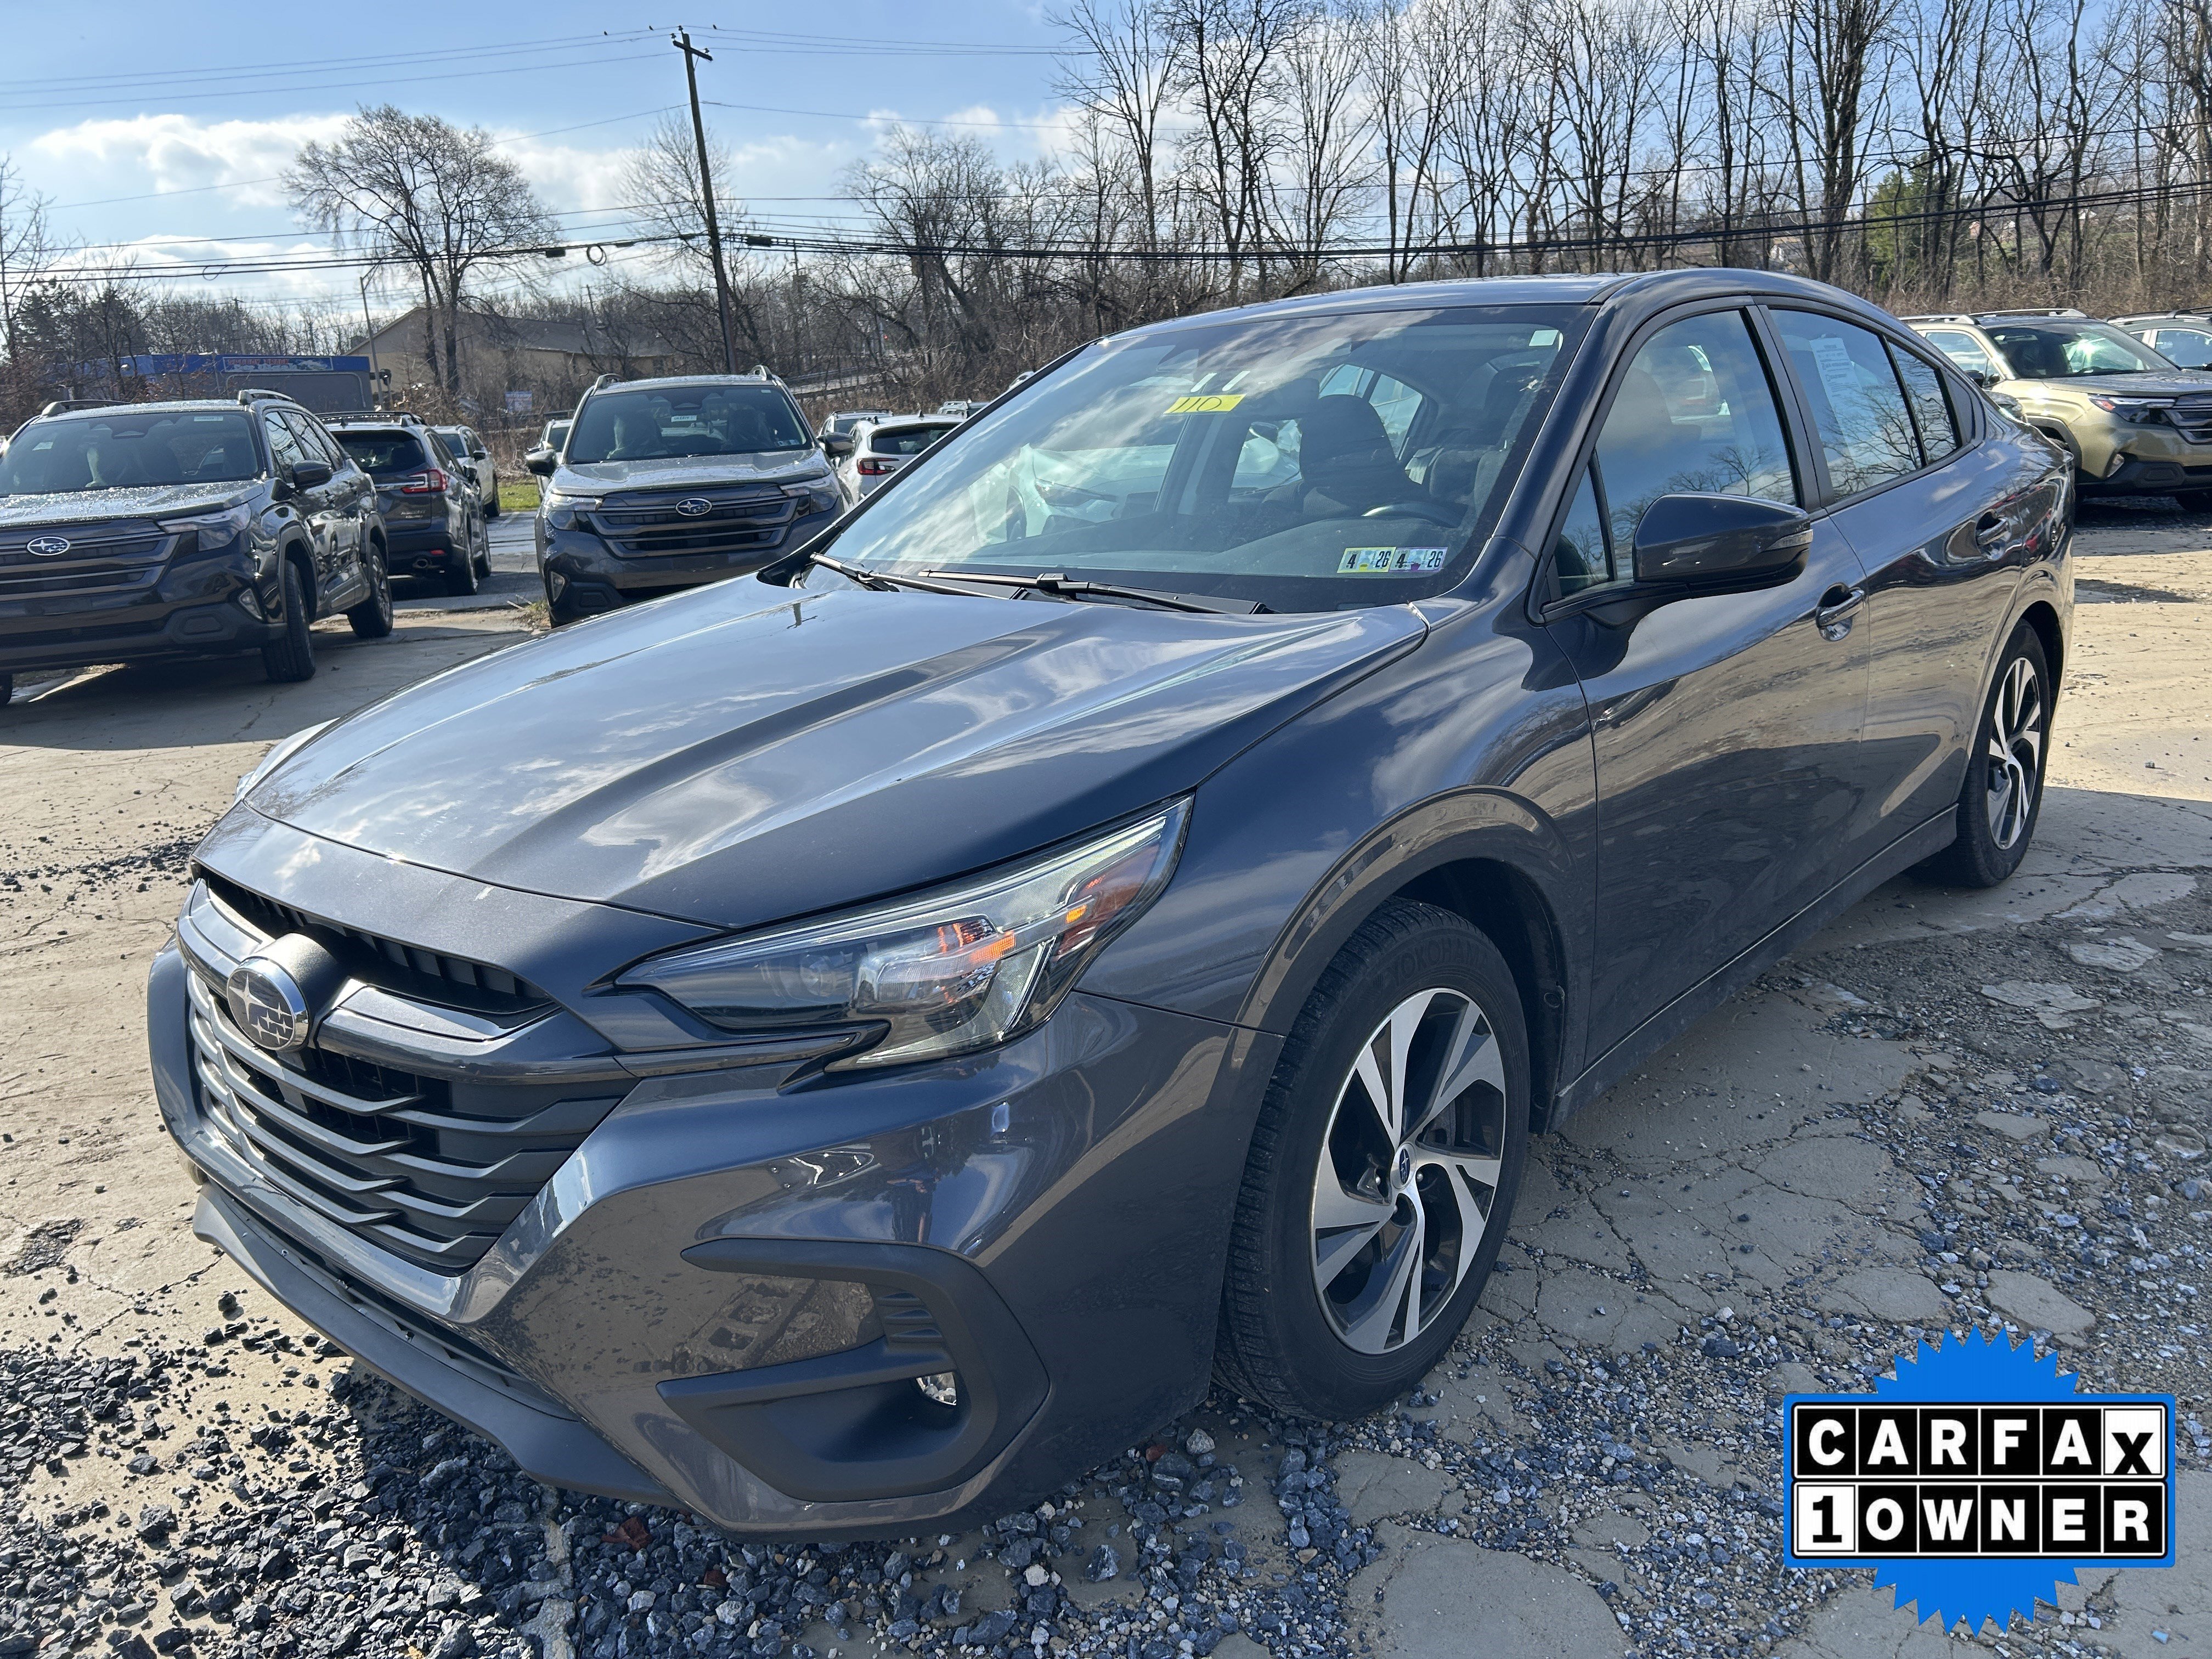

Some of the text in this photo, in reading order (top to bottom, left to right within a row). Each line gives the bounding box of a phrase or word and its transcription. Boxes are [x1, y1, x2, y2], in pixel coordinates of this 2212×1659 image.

[1347, 551, 1391, 569] 4 26
[1397, 550, 1443, 568] 4 26
